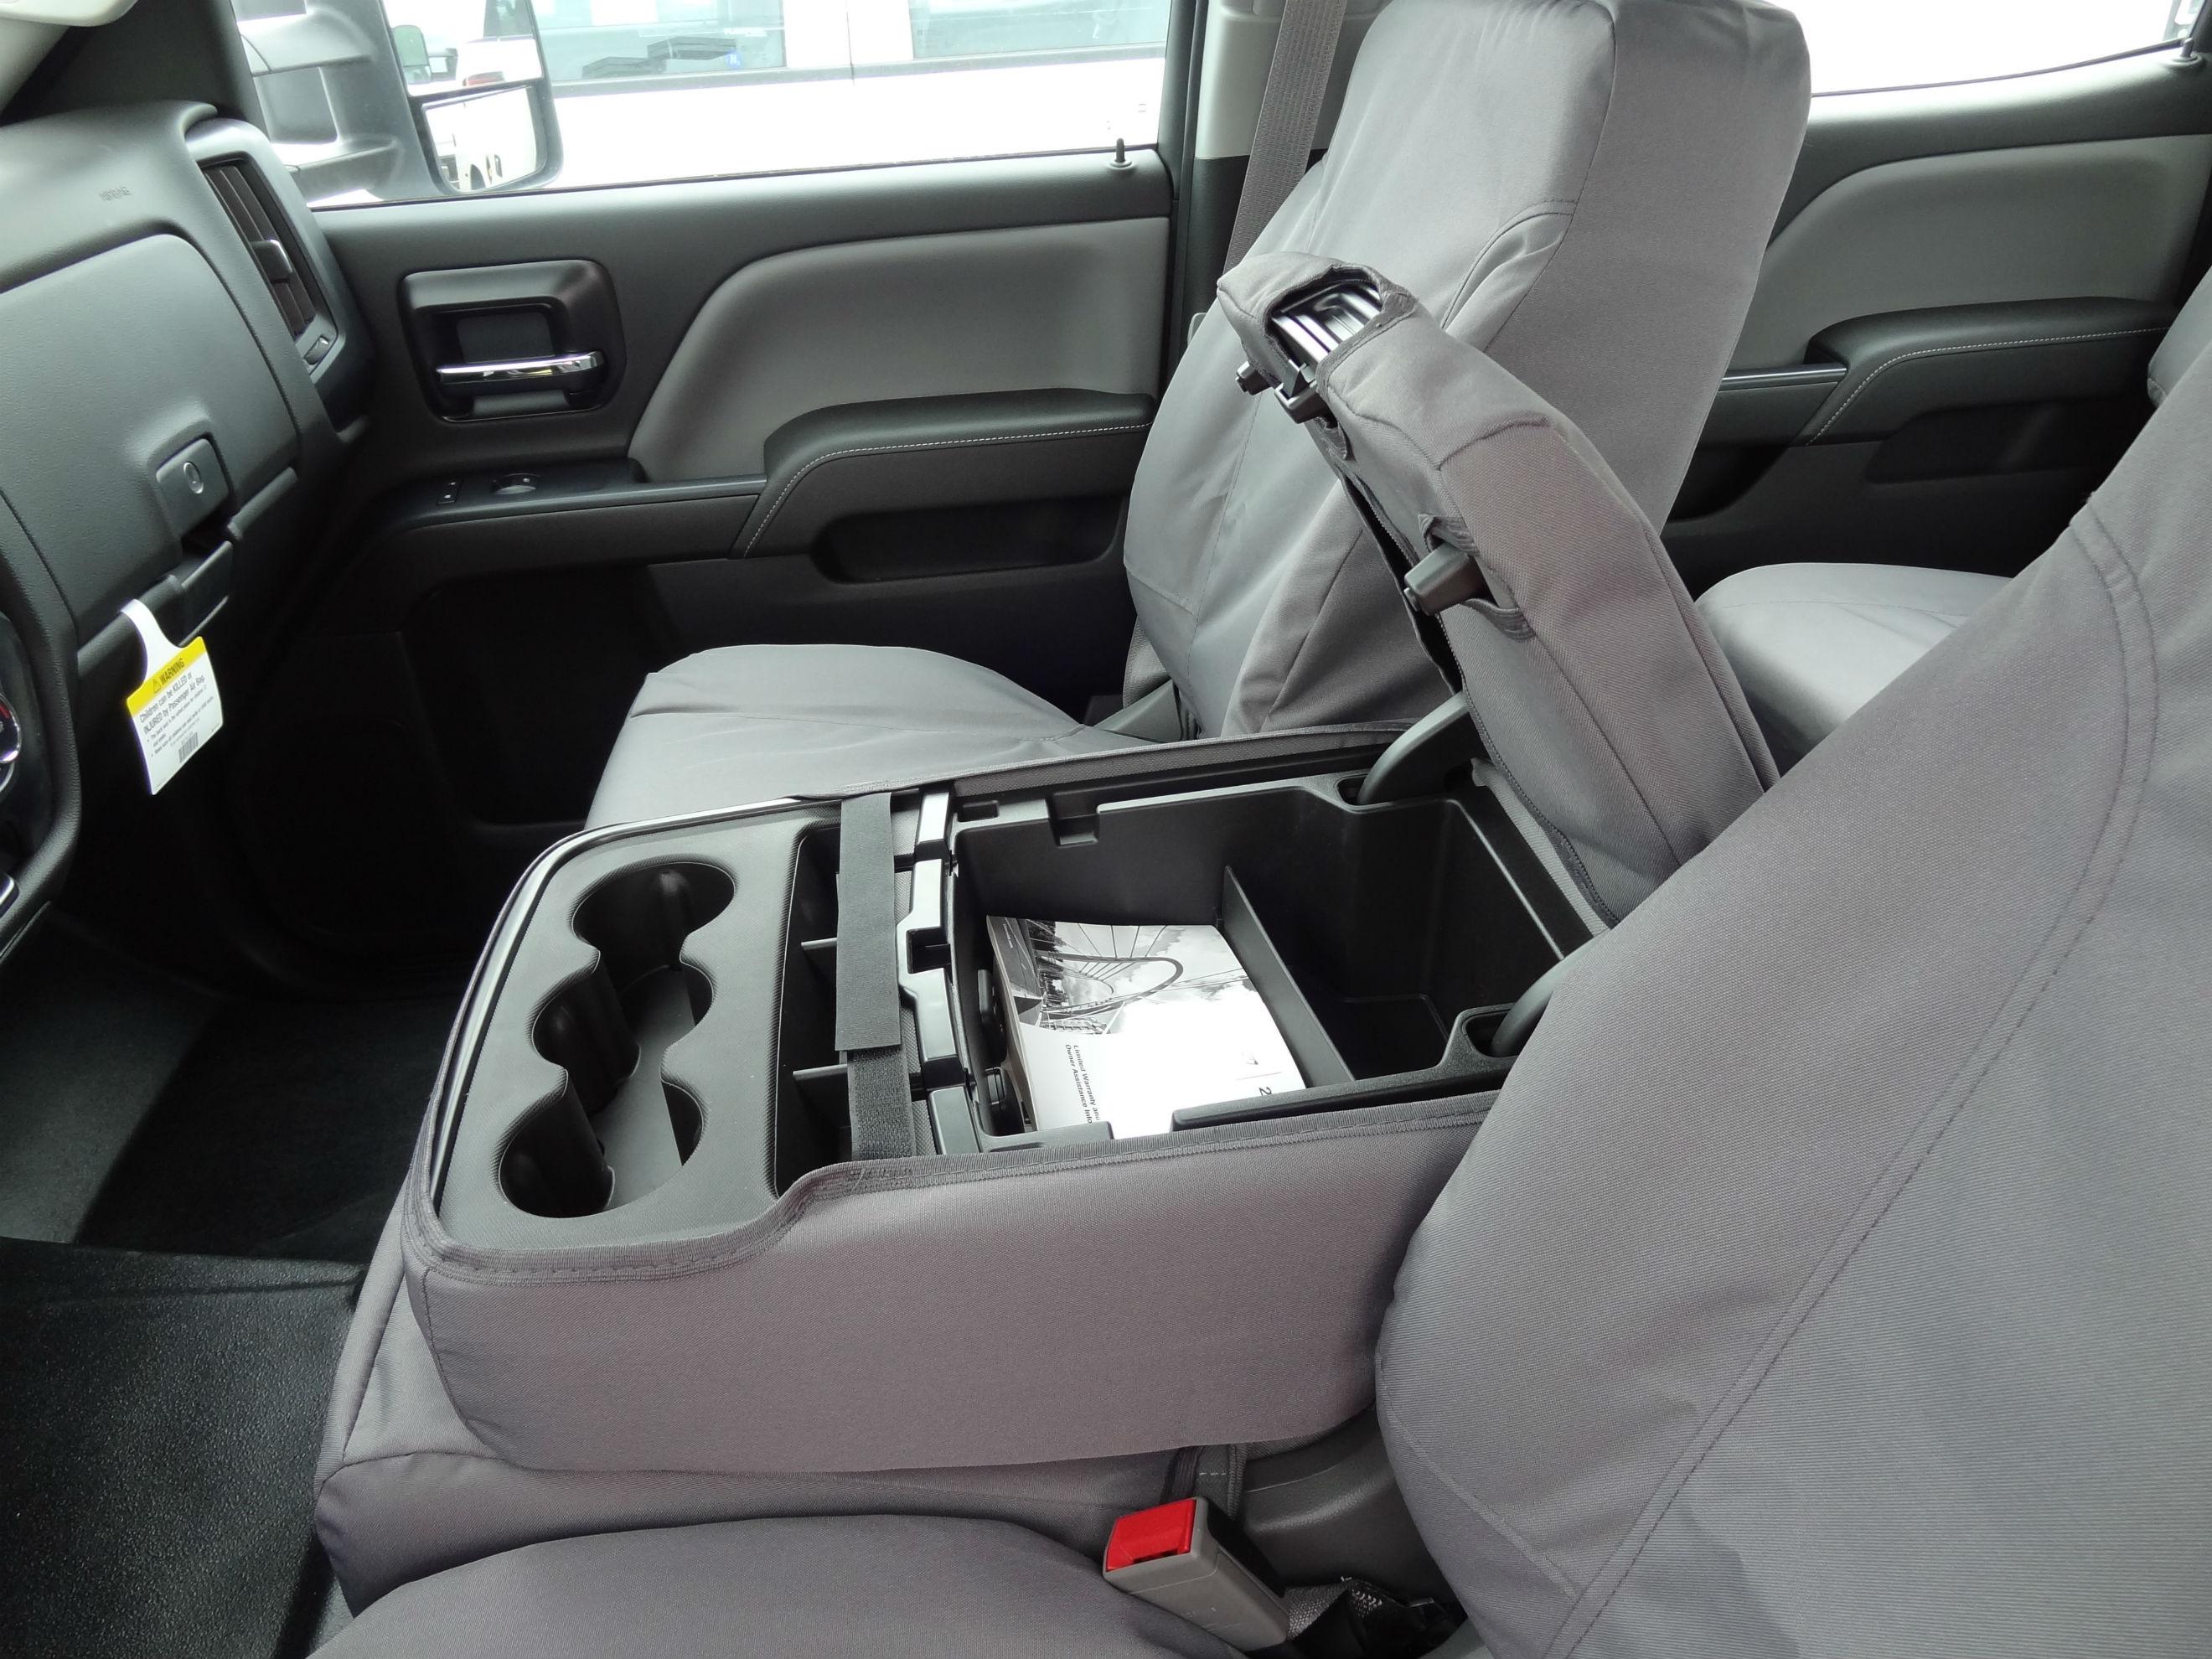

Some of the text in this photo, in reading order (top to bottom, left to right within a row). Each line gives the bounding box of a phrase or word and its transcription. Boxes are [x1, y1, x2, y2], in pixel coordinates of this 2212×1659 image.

[159, 658, 185, 685] WARNING
[140, 703, 159, 723] Children
[172, 675, 188, 692] KILLED
[143, 712, 163, 734] INJURED
[168, 688, 189, 711] Passenger
[1065, 1044, 1076, 1067] Owner
[1072, 1068, 1088, 1108] Assistance
[1073, 1045, 1086, 1072] Limited
[1082, 1073, 1096, 1106] Warranty
